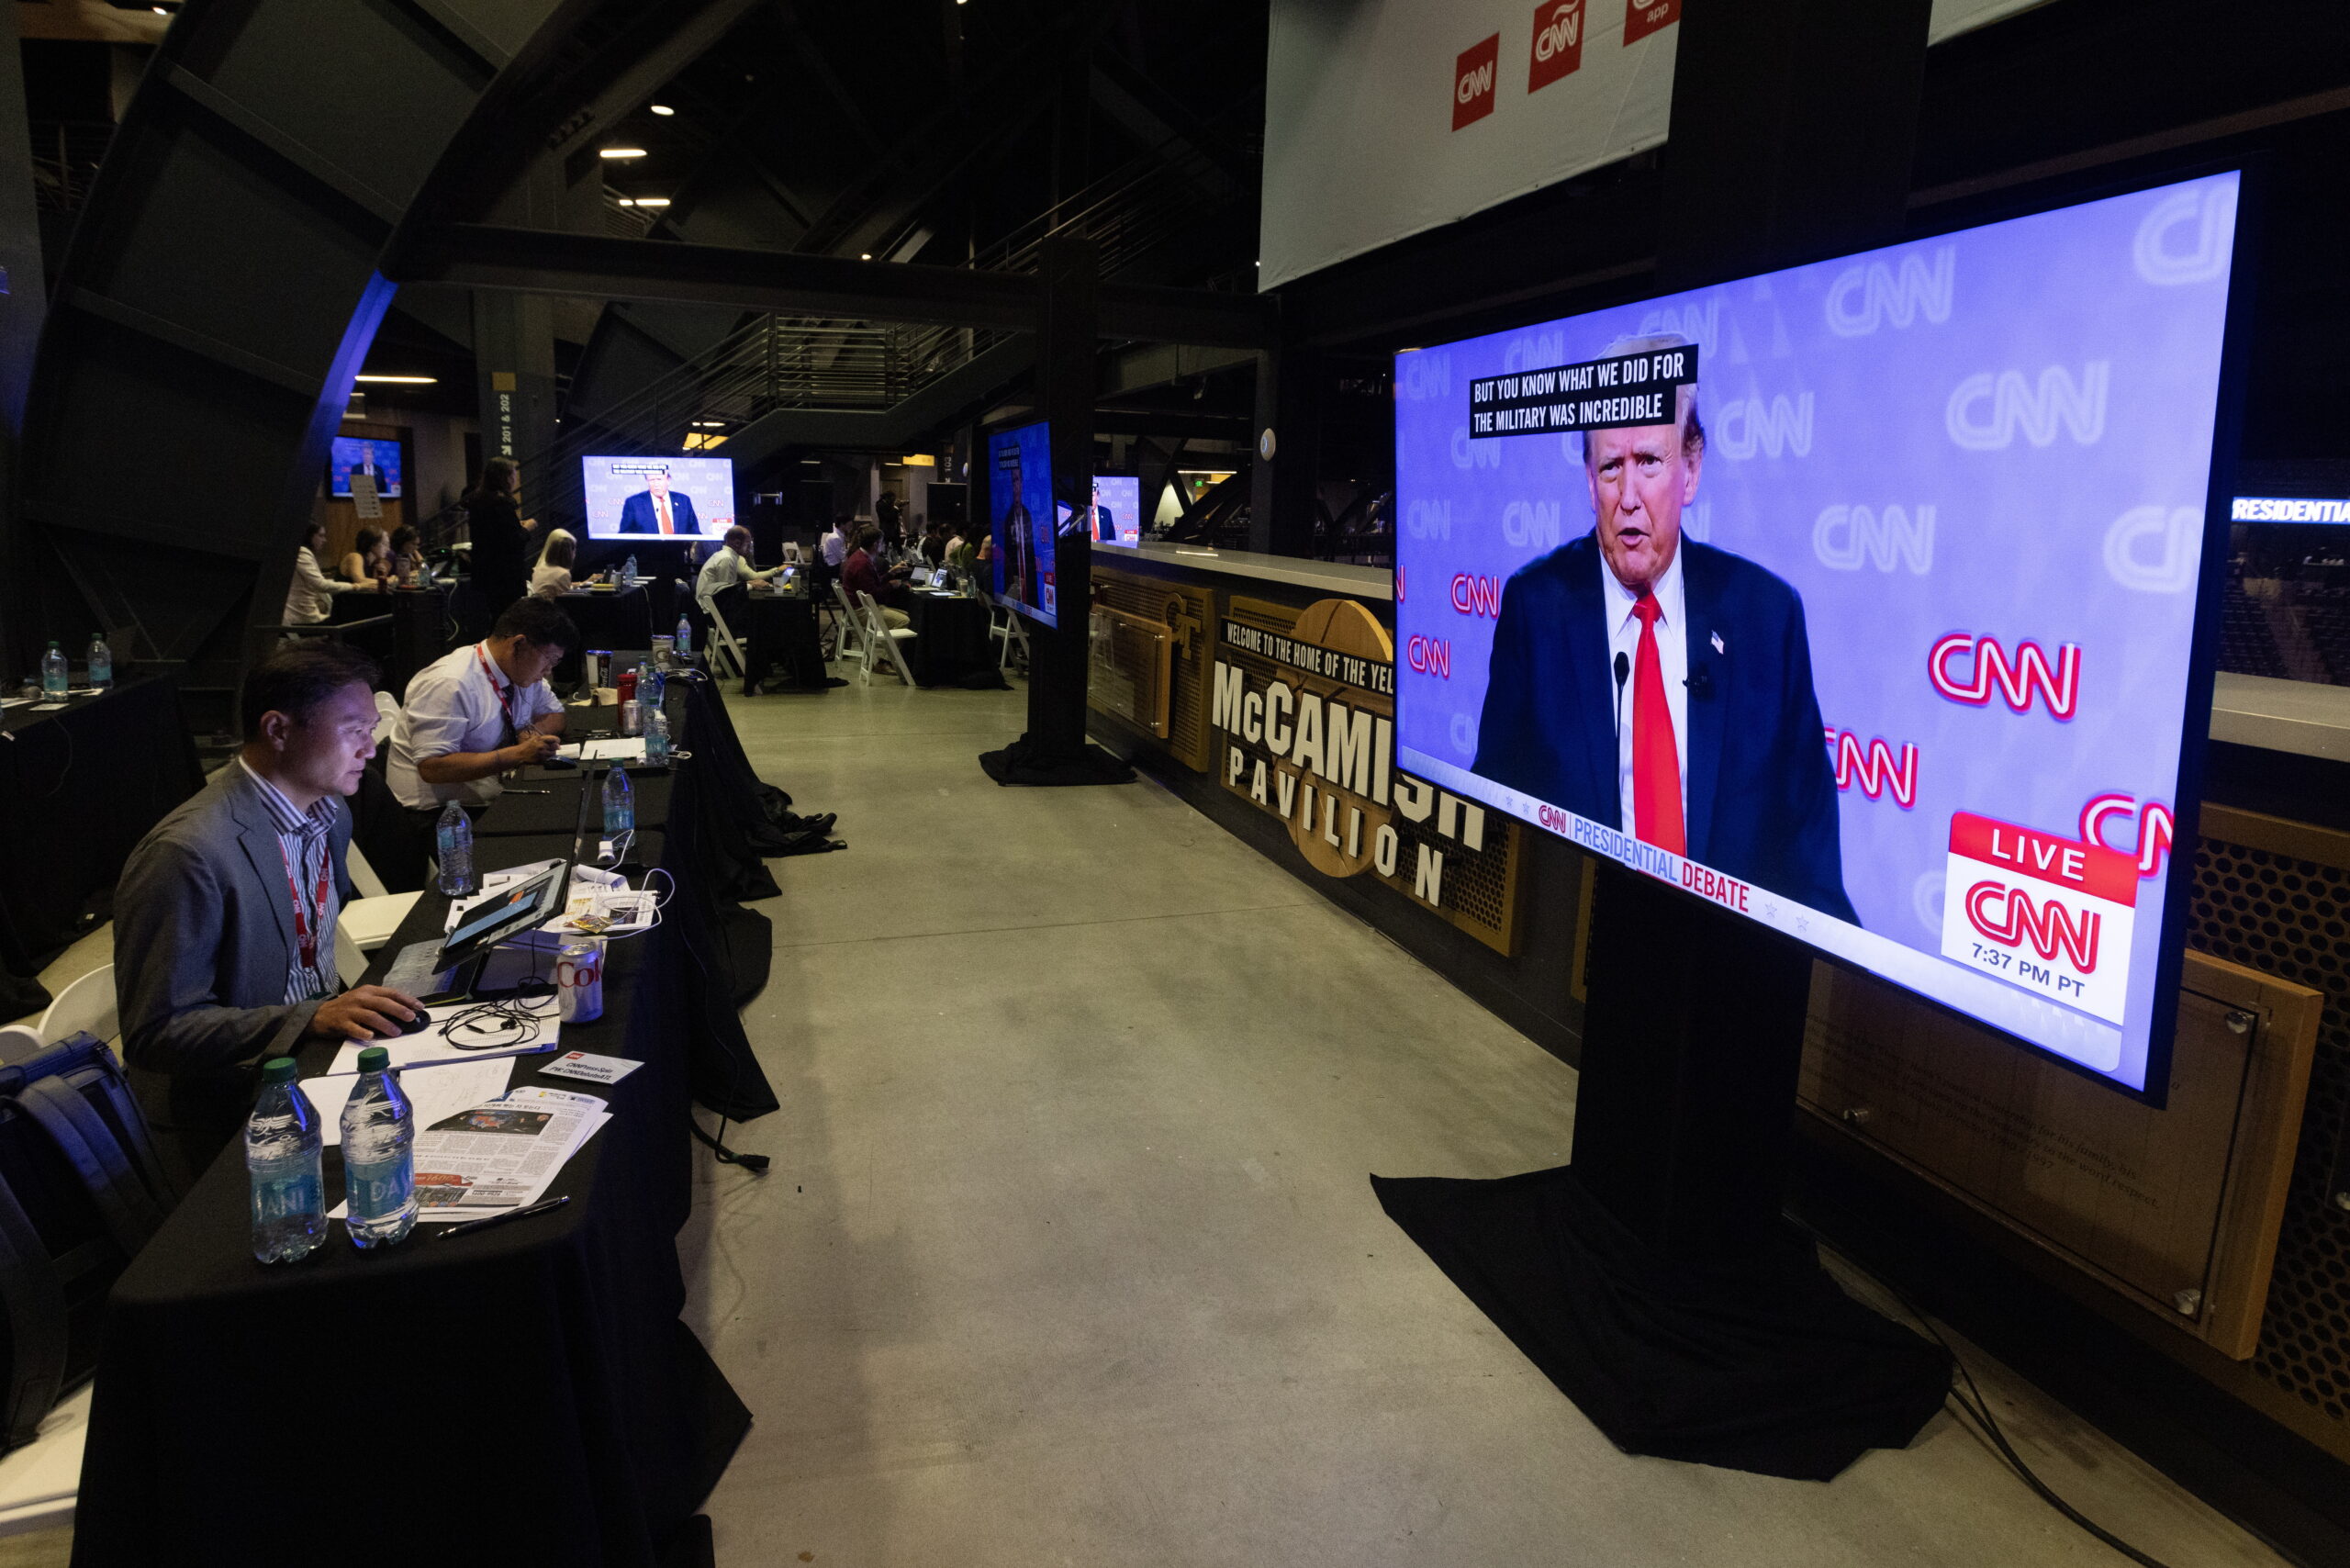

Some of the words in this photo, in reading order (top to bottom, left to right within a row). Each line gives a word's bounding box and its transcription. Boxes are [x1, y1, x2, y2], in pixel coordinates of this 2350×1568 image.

[1646, 3, 1669, 23] app
[1458, 60, 1493, 104] CNN
[1825, 243, 1956, 338] CNN
[500, 394, 509, 412] 202
[1406, 353, 1450, 400] CNN
[1474, 382, 1494, 403] BUT
[1497, 377, 1518, 400] YOU
[1521, 372, 1556, 397] KNOW
[1559, 366, 1594, 392] WHAT
[1597, 362, 1618, 387] WE
[1623, 358, 1649, 385] DID
[1653, 353, 1684, 380] FOR
[1474, 412, 1494, 433] THE
[1495, 406, 1547, 431] MILITARY
[1549, 403, 1576, 426] WAS
[1580, 393, 1662, 424] INCREDIBLE
[1715, 391, 1814, 459] CNN
[1945, 360, 2109, 451] CNN
[1406, 499, 1450, 542] CNN
[1502, 499, 1561, 548] CNN
[1813, 504, 1937, 576] CNN
[1451, 574, 1499, 619] CNN
[1227, 622, 1261, 653] WELCOME
[1263, 633, 1273, 656] TO
[1276, 637, 1291, 663] THE
[1293, 643, 1321, 673] HOME
[1324, 652, 1339, 678] OF
[1343, 656, 1367, 687] THE
[1407, 633, 1450, 678] CNN
[1929, 633, 2081, 721] CNN
[1825, 726, 1919, 810] NN
[1228, 749, 1444, 908] PAVILION
[1992, 828, 2086, 881] LIVE
[1539, 804, 1566, 834] CNN
[1574, 817, 1678, 883] PRESIDENTIAL
[1682, 861, 1750, 913] DEBATE
[1965, 879, 2101, 974] CNN
[1972, 942, 2012, 970] 7:37
[2019, 960, 2050, 986] PM
[2057, 975, 2086, 998] PT
